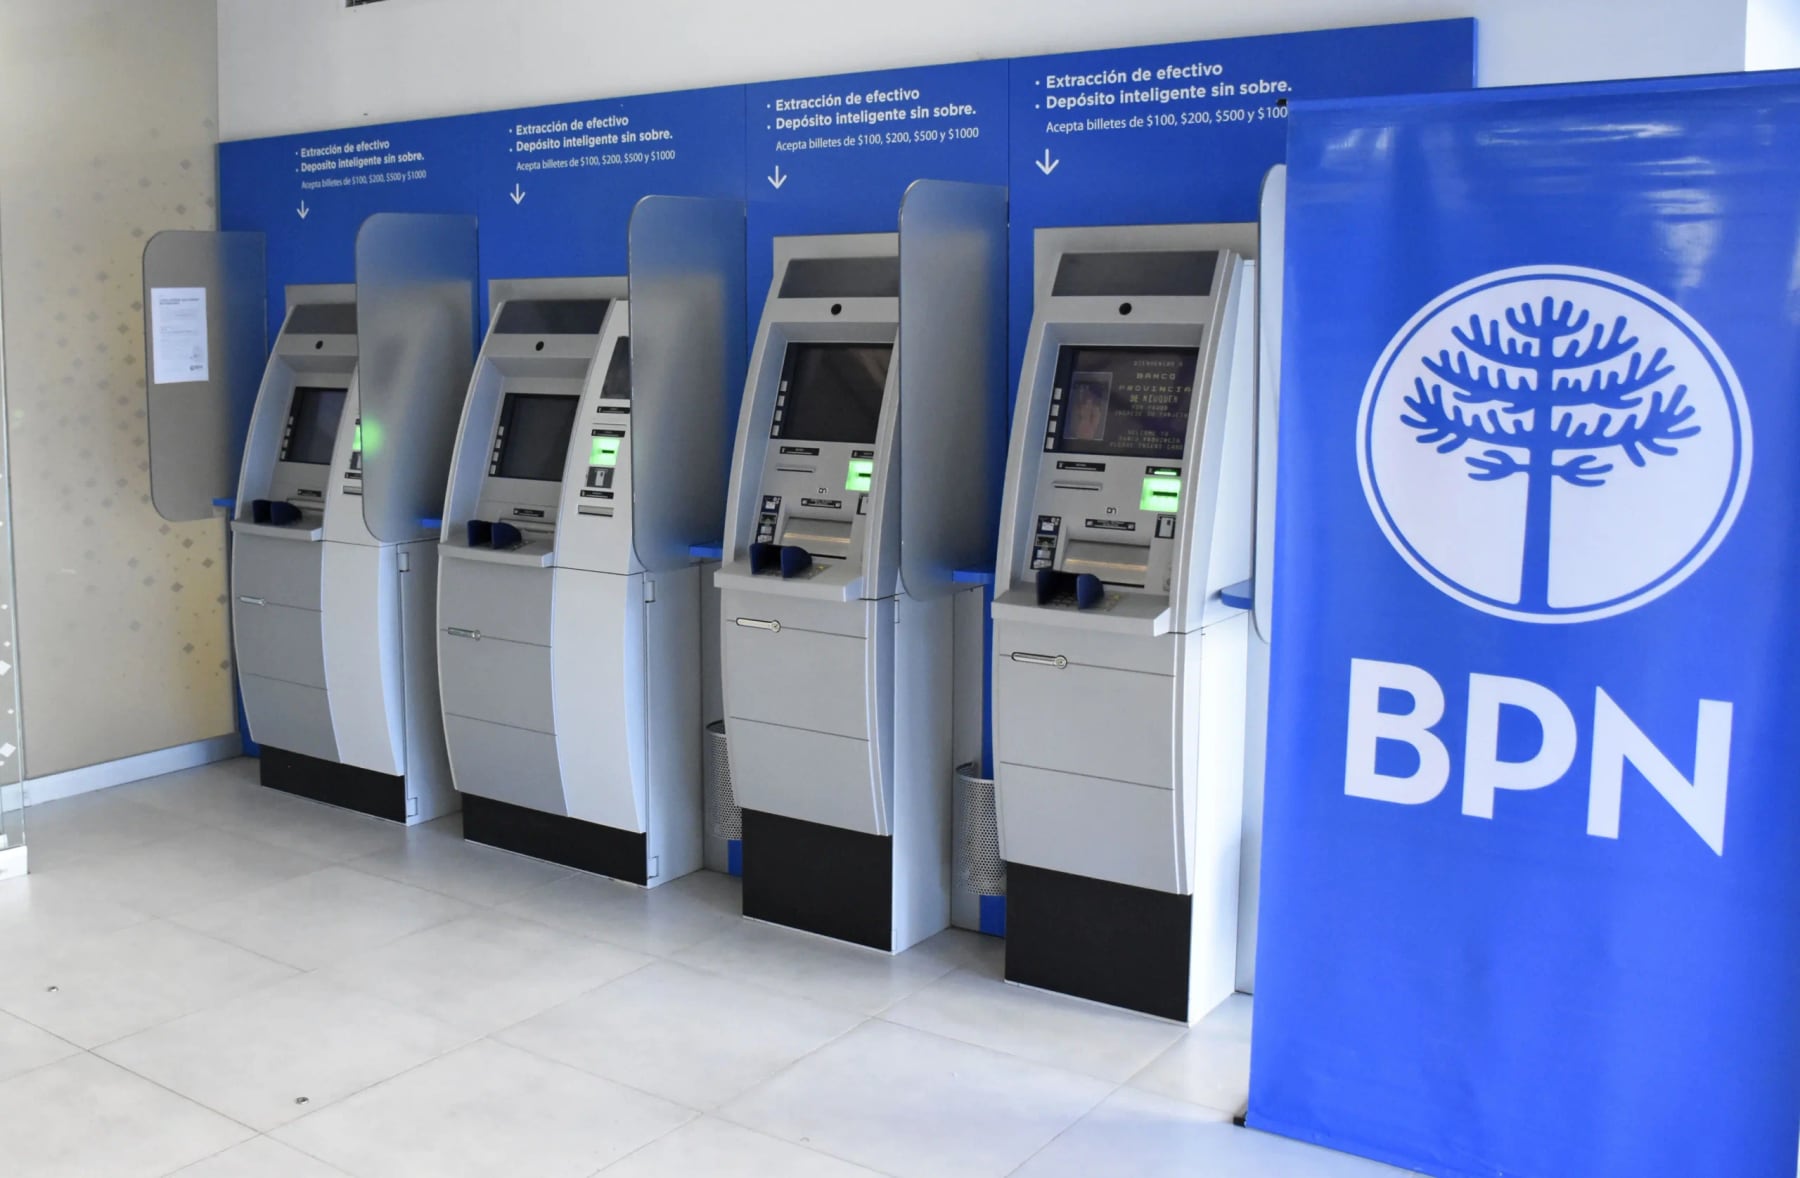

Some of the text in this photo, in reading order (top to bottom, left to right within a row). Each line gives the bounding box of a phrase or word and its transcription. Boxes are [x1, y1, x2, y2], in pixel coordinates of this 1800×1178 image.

[1046, 62, 1223, 89] Extracción de efectivo
[776, 88, 920, 111] Extracción de efectivo
[1046, 79, 1292, 110] Depósito inteligente sin sobre.
[516, 115, 629, 135] Extracción de efectivo
[776, 104, 976, 130] Depósito inteligente sin sobre.
[1046, 120, 1084, 135] Acepta
[1087, 117, 1127, 131] billetes
[1129, 115, 1144, 128] de
[1146, 113, 1178, 128] $100,
[1180, 111, 1212, 126] $200,
[1215, 109, 1245, 123] $500
[1247, 111, 1255, 123] y
[301, 140, 390, 157] Extracción de efectivo
[516, 129, 673, 152] Depósito inteligente sin sobre.
[775, 127, 979, 152] Acepta billetes de $100, $200, $500 y $1000
[384, 153, 396, 164] sin
[397, 152, 424, 163] sobre.
[516, 149, 676, 172] Acepta billetes de $100, $200, $500 y $1000
[1344, 657, 1733, 857] BPN
